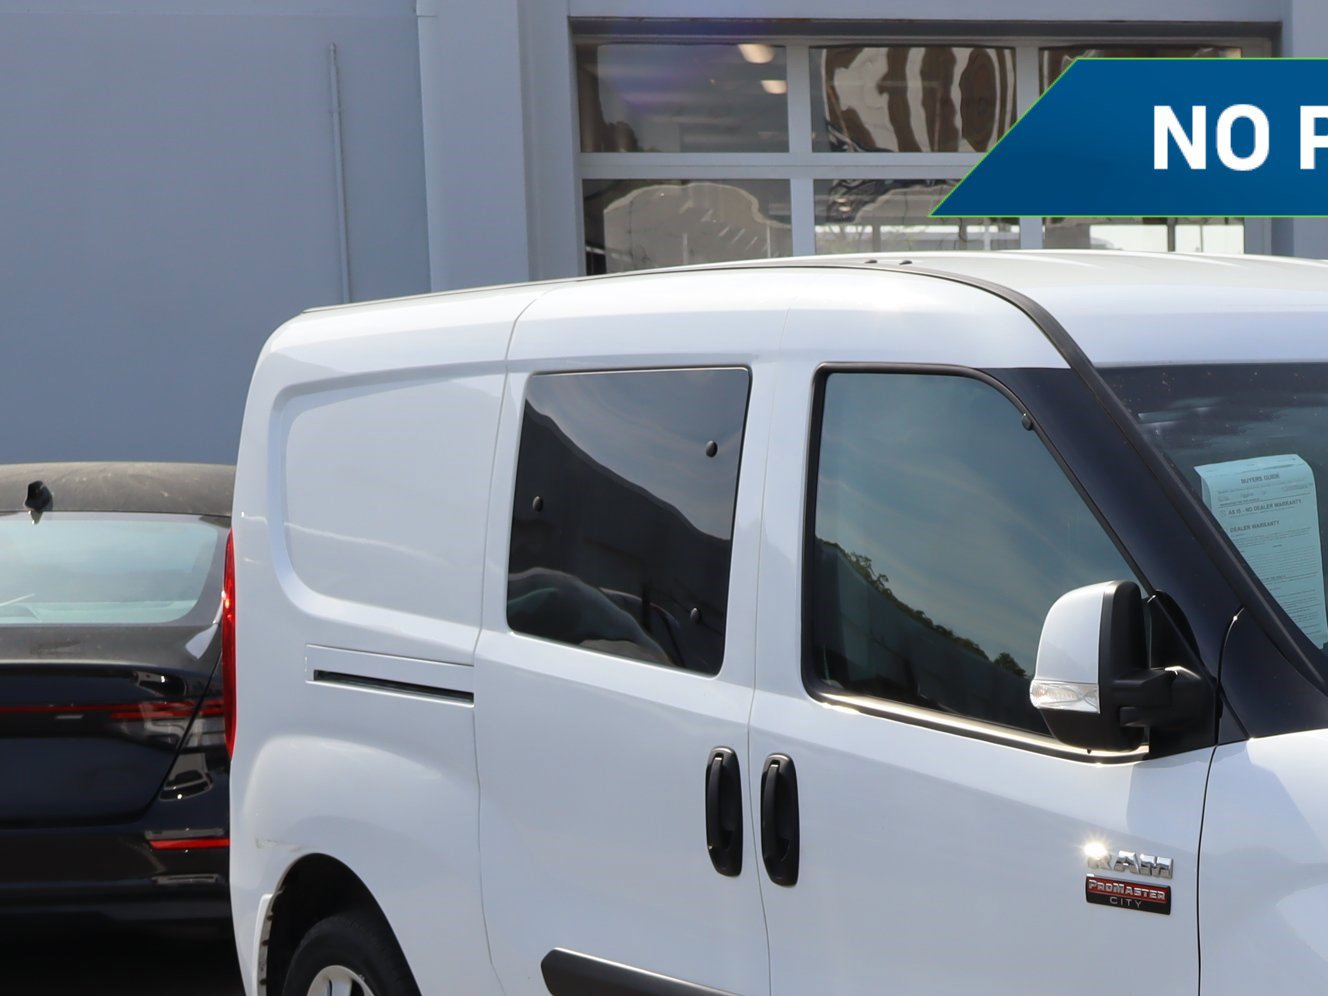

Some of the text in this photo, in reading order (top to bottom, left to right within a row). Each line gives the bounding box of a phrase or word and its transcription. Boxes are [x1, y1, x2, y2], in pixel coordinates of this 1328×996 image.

[1253, 503, 1274, 512] DEALER
[1274, 499, 1302, 509] WARRANTY
[1230, 520, 1280, 533] DEALER WARRANTY
[1109, 896, 1142, 909] CITY
